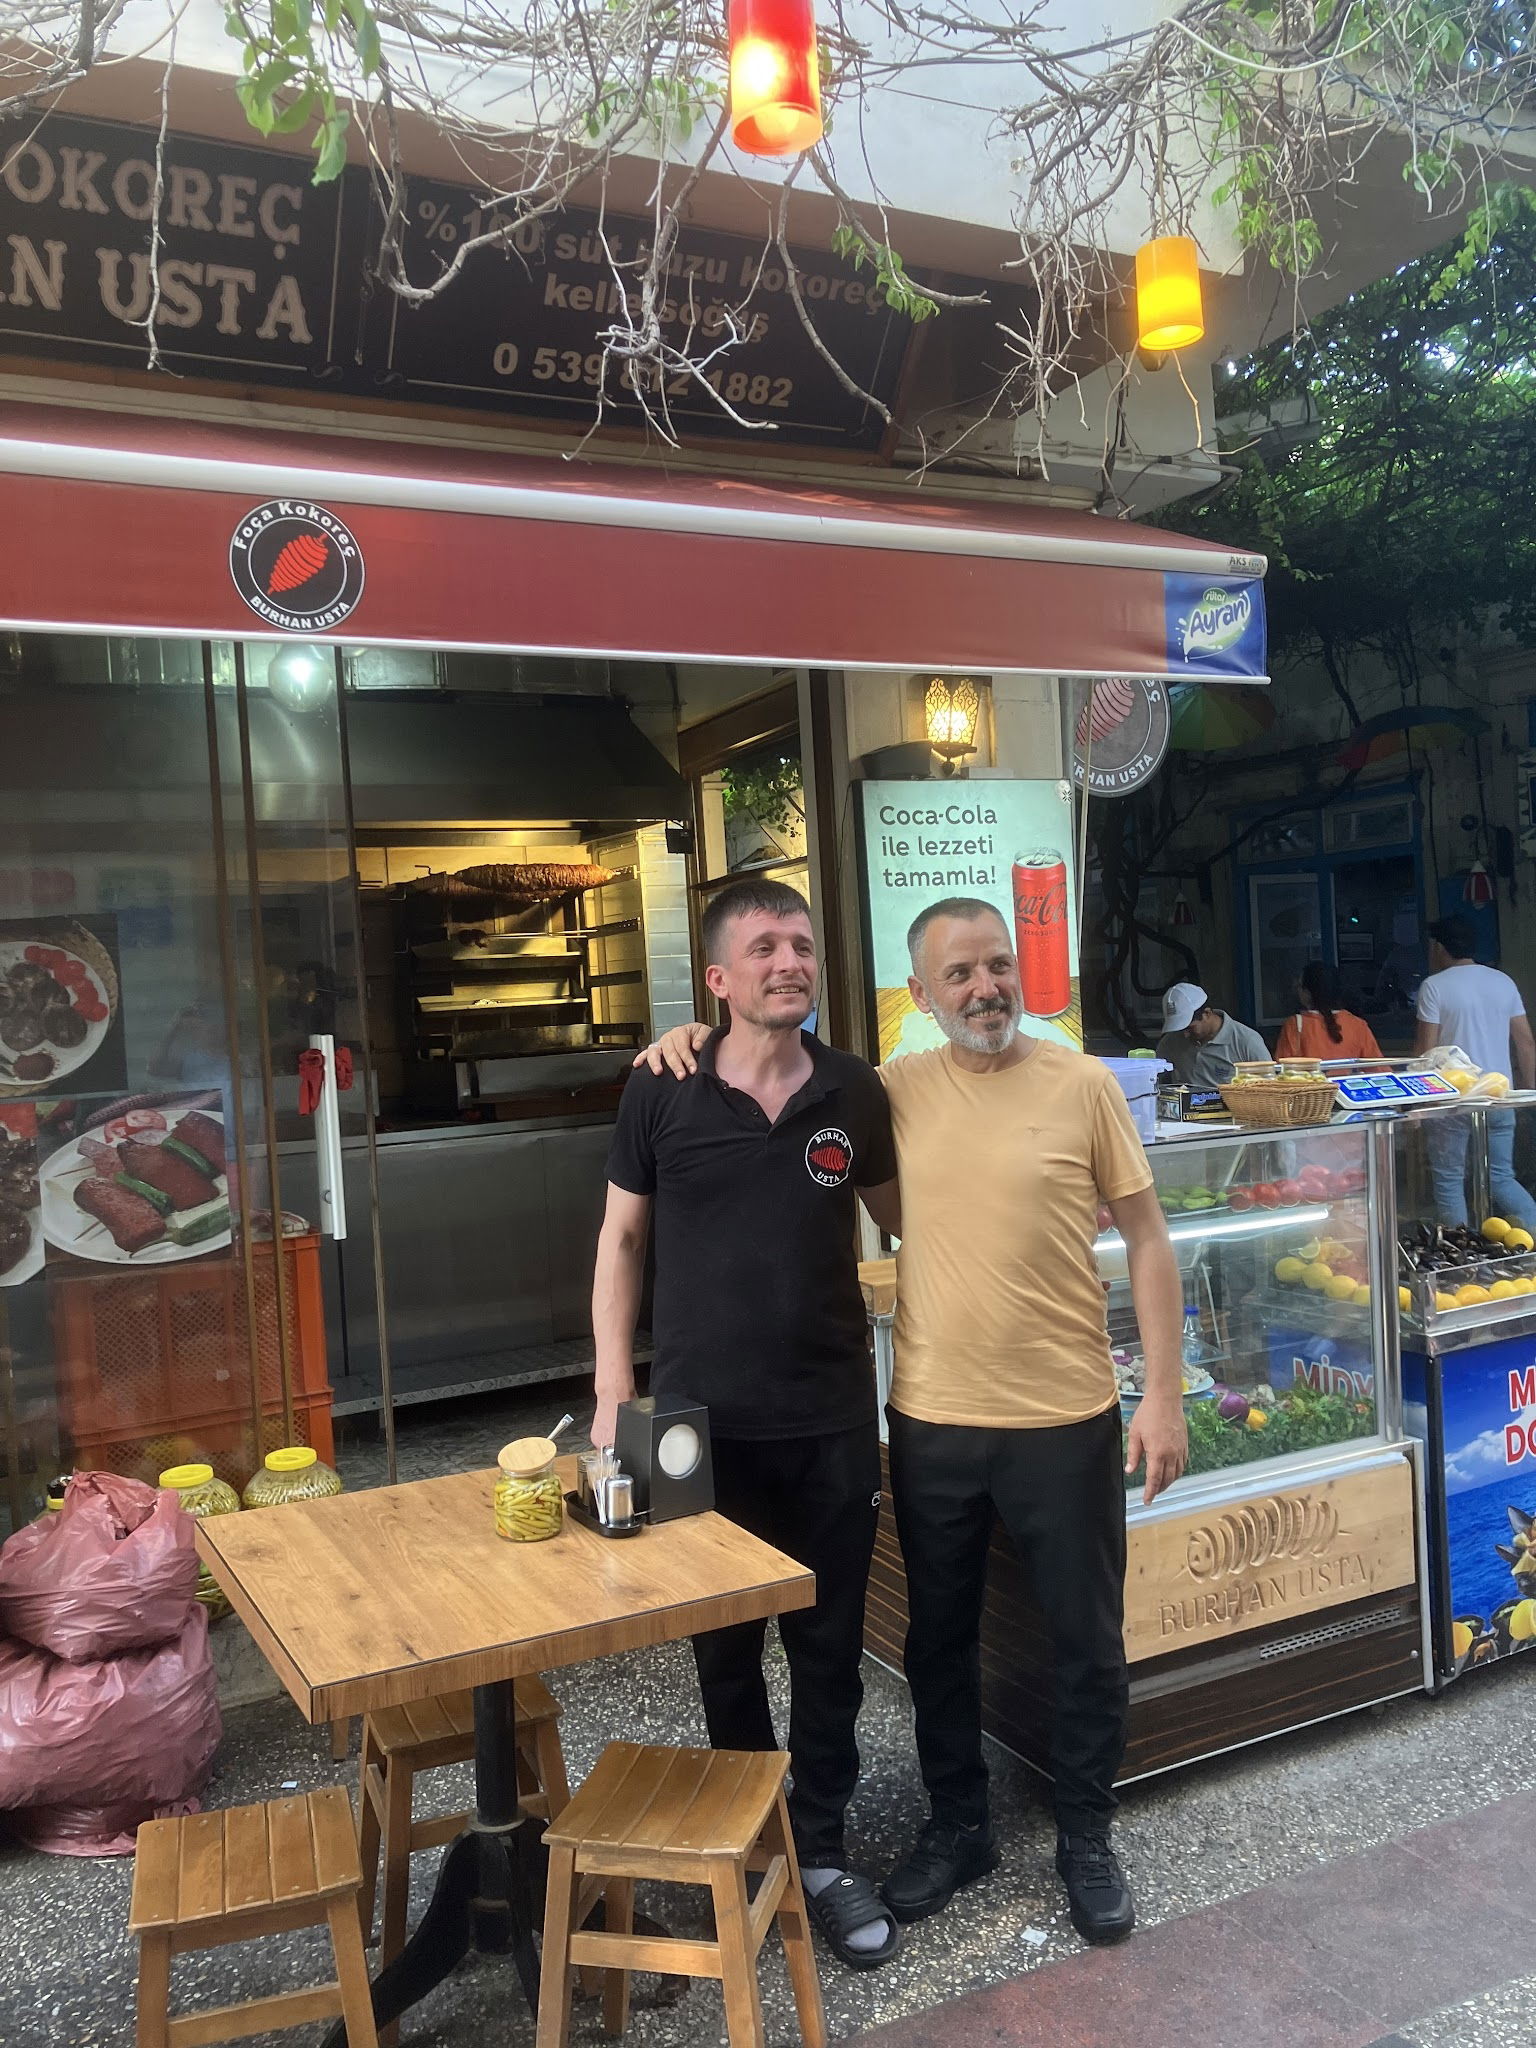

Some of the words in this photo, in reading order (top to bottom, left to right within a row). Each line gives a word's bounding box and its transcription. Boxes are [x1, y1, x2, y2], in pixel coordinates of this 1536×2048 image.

[0, 233, 68, 311] N
[94, 246, 313, 345] USTA
[492, 342, 519, 375] 0
[532, 346, 603, 386] 539
[706, 368, 794, 409] 1882
[233, 509, 273, 550] Foça
[278, 501, 356, 558] Kokoreç
[250, 595, 312, 629] BURHAN
[314, 601, 351, 627] USTA
[1189, 597, 1246, 639] Ayran
[1119, 753, 1154, 784] USTA
[881, 836, 909, 856] ile
[918, 835, 994, 856] lezzeti
[883, 865, 997, 888] tamamla!
[814, 1132, 849, 1149] BURHAN
[817, 1171, 840, 1184] USTA
[1158, 1574, 1287, 1638] BURHAN
[1297, 1553, 1368, 1599] USTA
